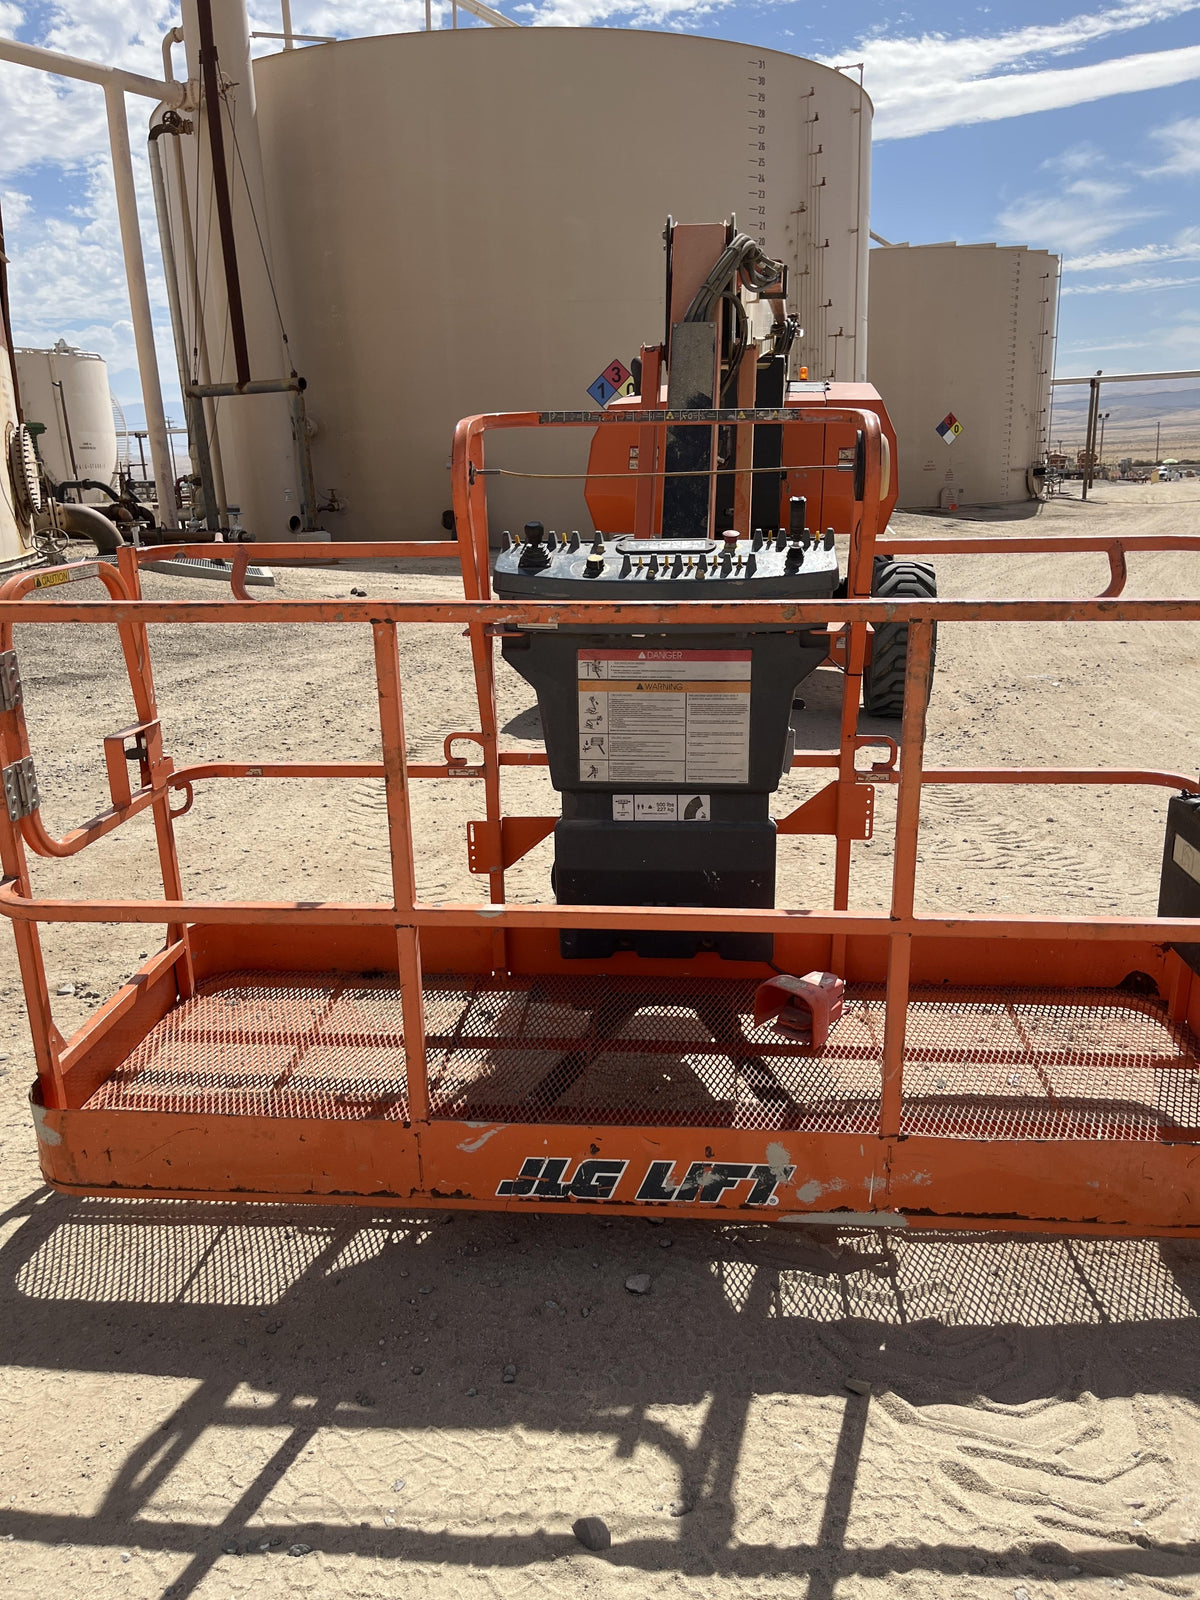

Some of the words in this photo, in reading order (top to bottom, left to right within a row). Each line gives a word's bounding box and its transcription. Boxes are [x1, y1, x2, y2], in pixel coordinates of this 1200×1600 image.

[758, 60, 766, 69] 31
[758, 76, 766, 86] 30
[758, 93, 766, 102] 29
[758, 109, 766, 118] 28
[758, 125, 766, 135] 27
[758, 141, 766, 151] 26
[758, 158, 766, 167] 25
[758, 174, 766, 183] 24
[758, 190, 766, 199] 23
[758, 206, 766, 215] 22
[759, 222, 766, 231] 21
[758, 237, 766, 246] 20
[611, 366, 621, 383] 3
[597, 382, 605, 399] 1
[953, 424, 959, 434] 0
[41, 572, 68, 586] CAUTION
[647, 651, 683, 660] DANGER
[644, 682, 684, 691] WARNING
[495, 1157, 630, 1199] JLG
[635, 1160, 797, 1206] LIFT
